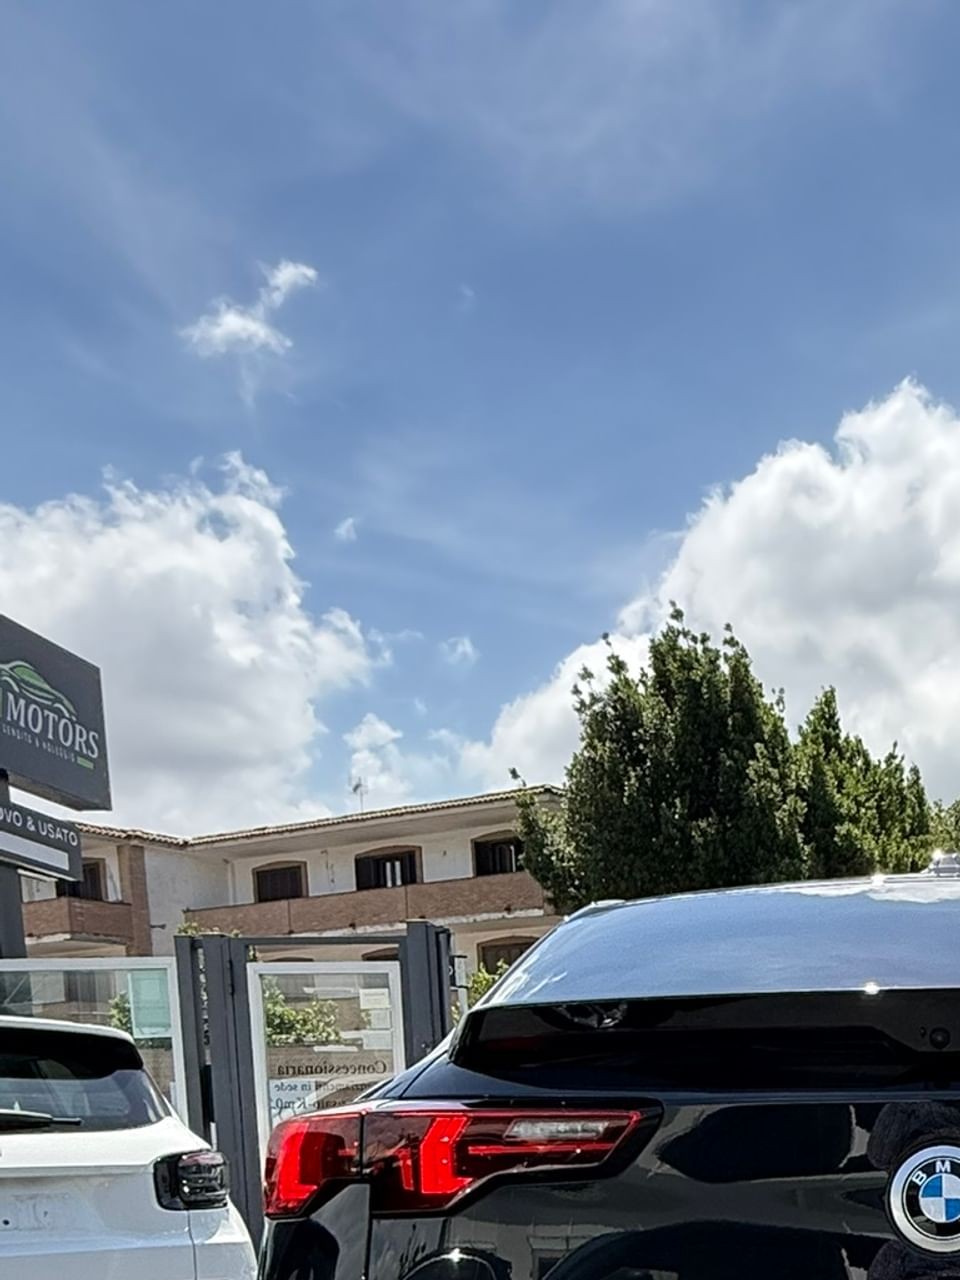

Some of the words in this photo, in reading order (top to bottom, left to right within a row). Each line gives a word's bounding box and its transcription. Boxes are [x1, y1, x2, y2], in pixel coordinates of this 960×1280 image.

[7, 691, 99, 759] MOTORS
[26, 816, 36, 833] &
[37, 820, 79, 847] USATO
